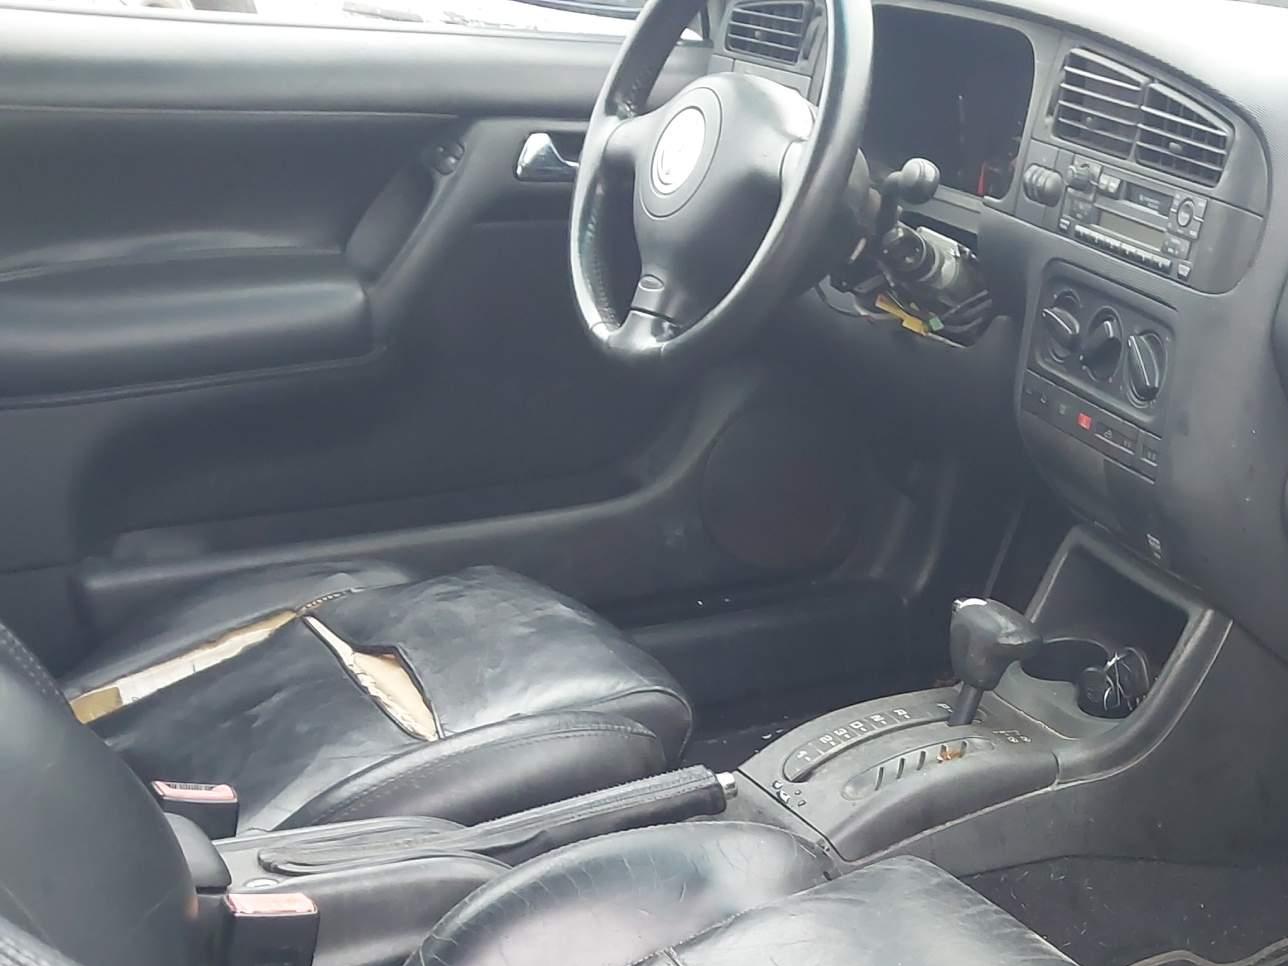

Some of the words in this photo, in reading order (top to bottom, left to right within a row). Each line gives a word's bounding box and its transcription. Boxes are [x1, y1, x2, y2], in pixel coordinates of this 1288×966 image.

[893, 708, 908, 716] R
[849, 721, 863, 730] D
[834, 728, 848, 736] 3
[819, 735, 832, 744] 2
